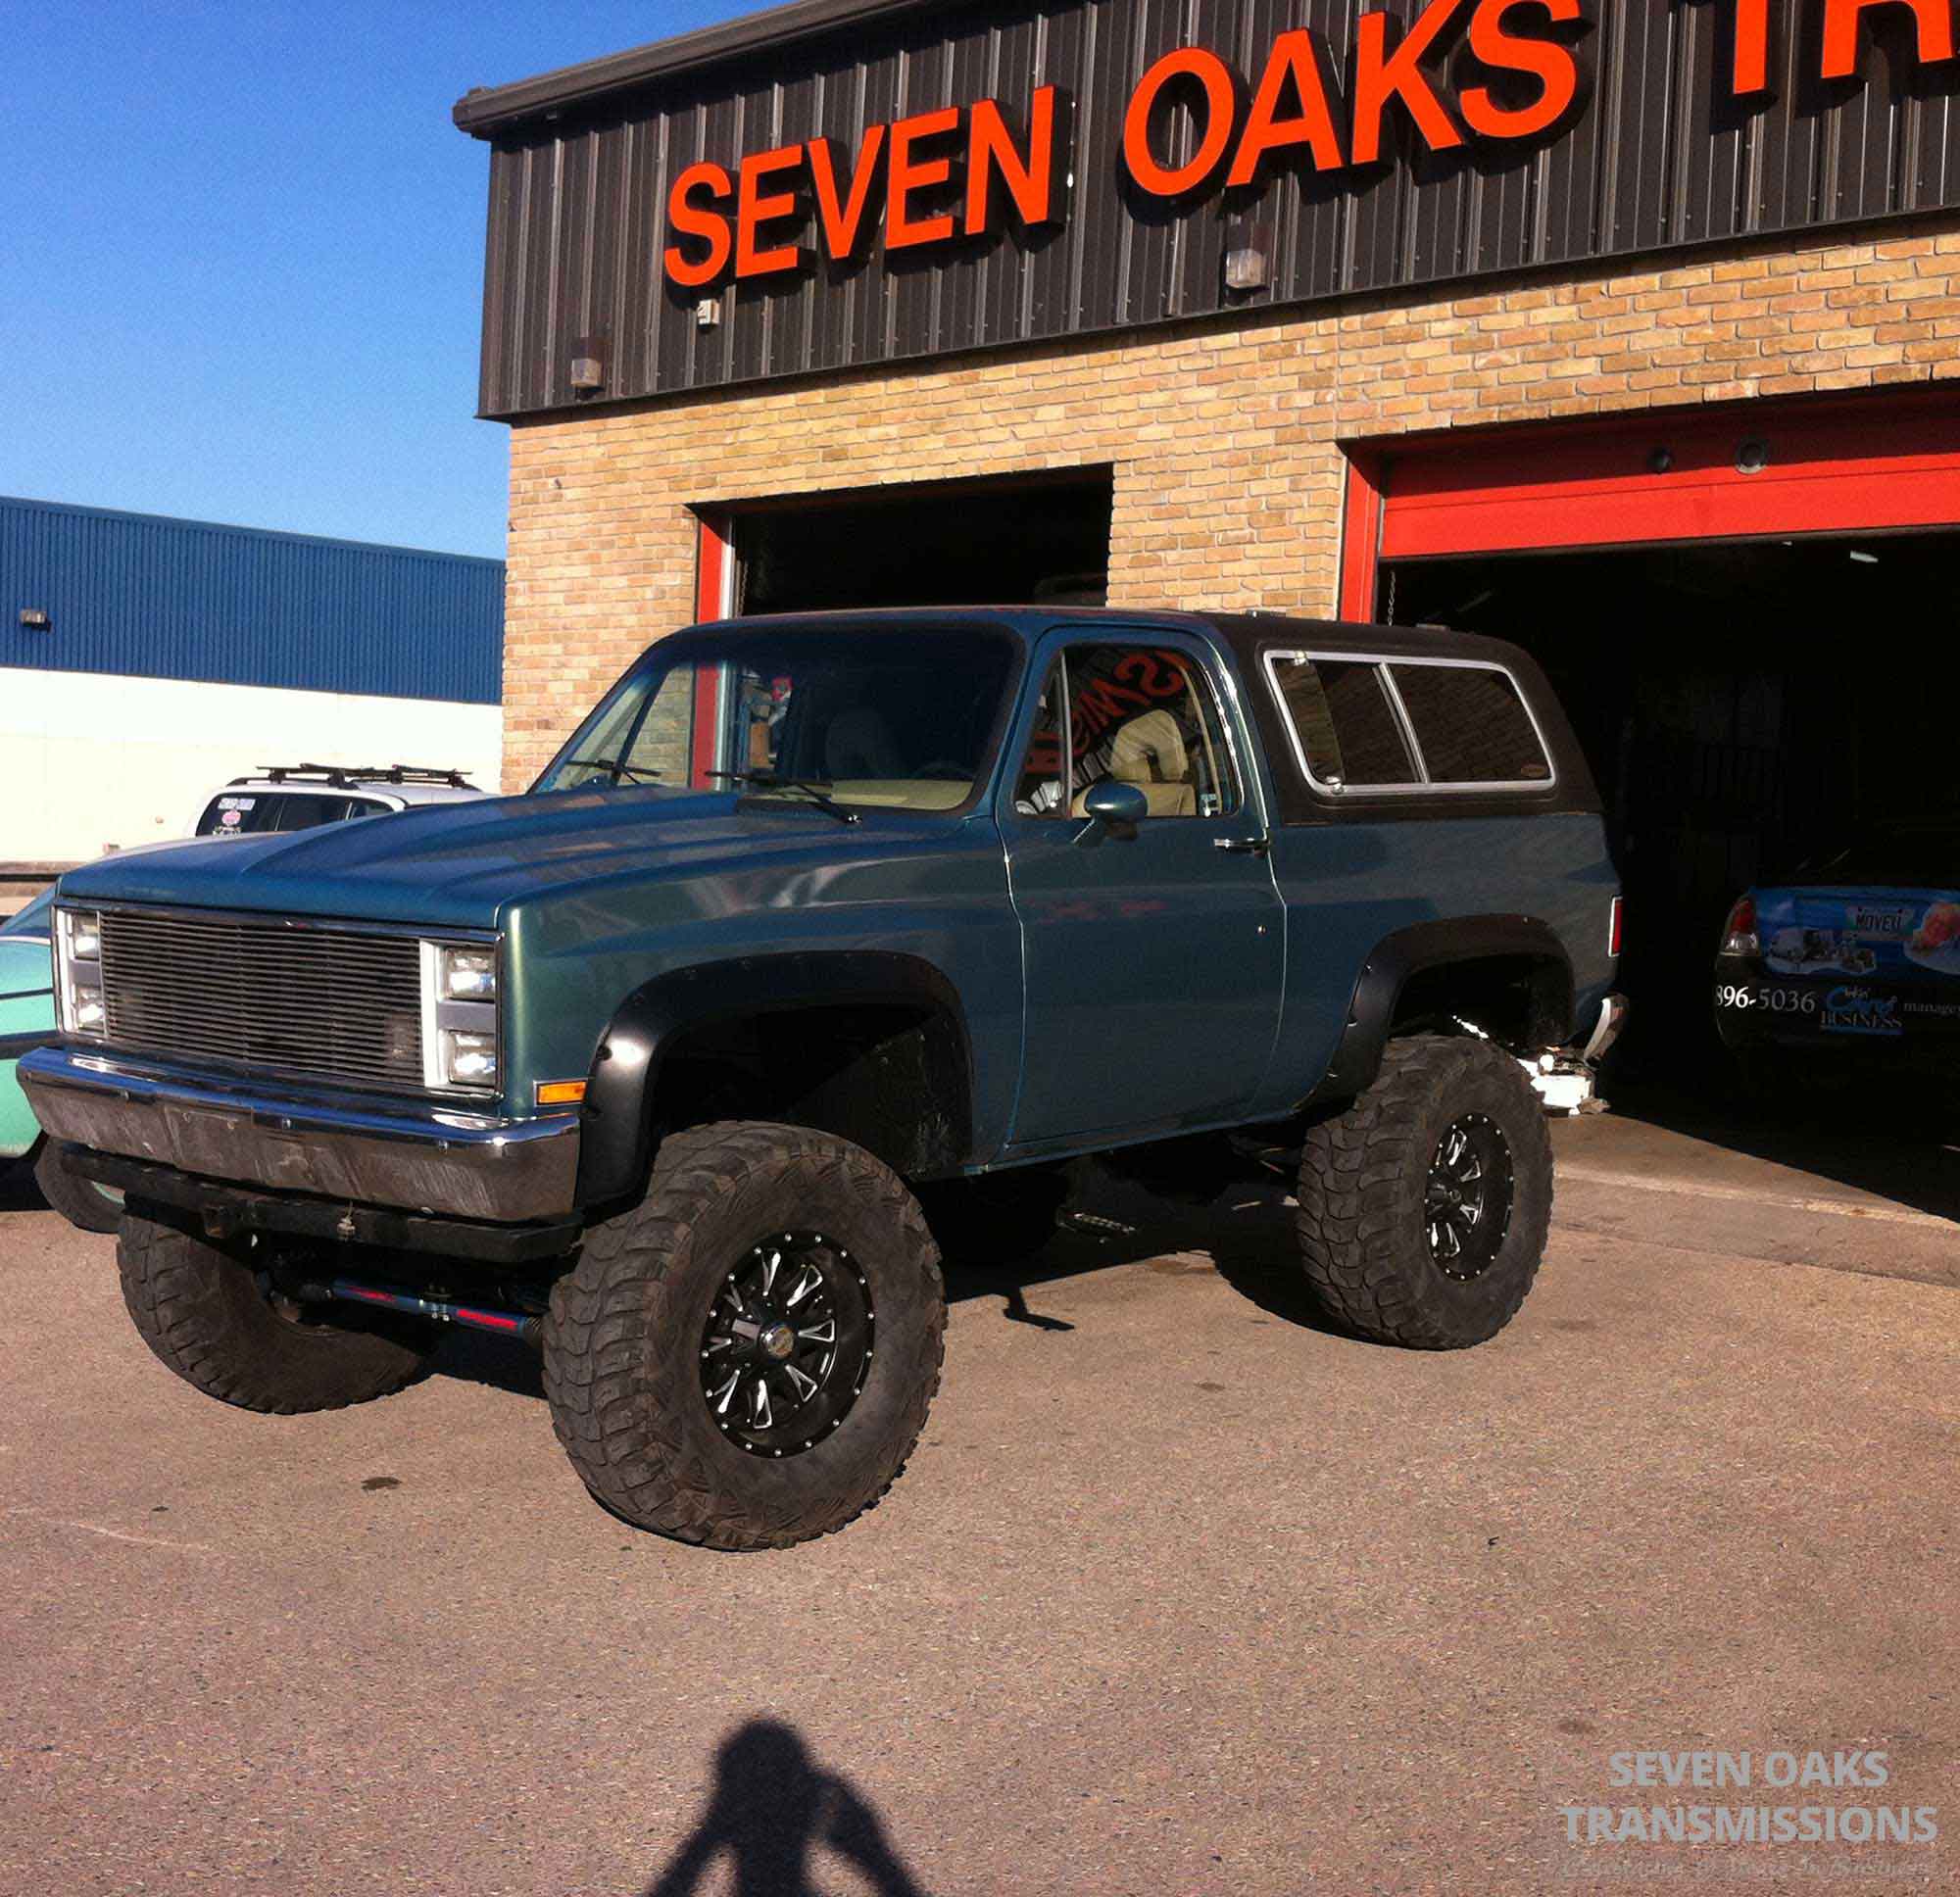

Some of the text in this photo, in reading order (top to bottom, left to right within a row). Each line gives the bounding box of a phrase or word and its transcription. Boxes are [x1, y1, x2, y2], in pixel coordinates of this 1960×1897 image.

[663, 85, 1054, 286] SEVEN
[1123, 0, 1579, 195] OAKS
[1716, 984, 1815, 1012] 896-5036
